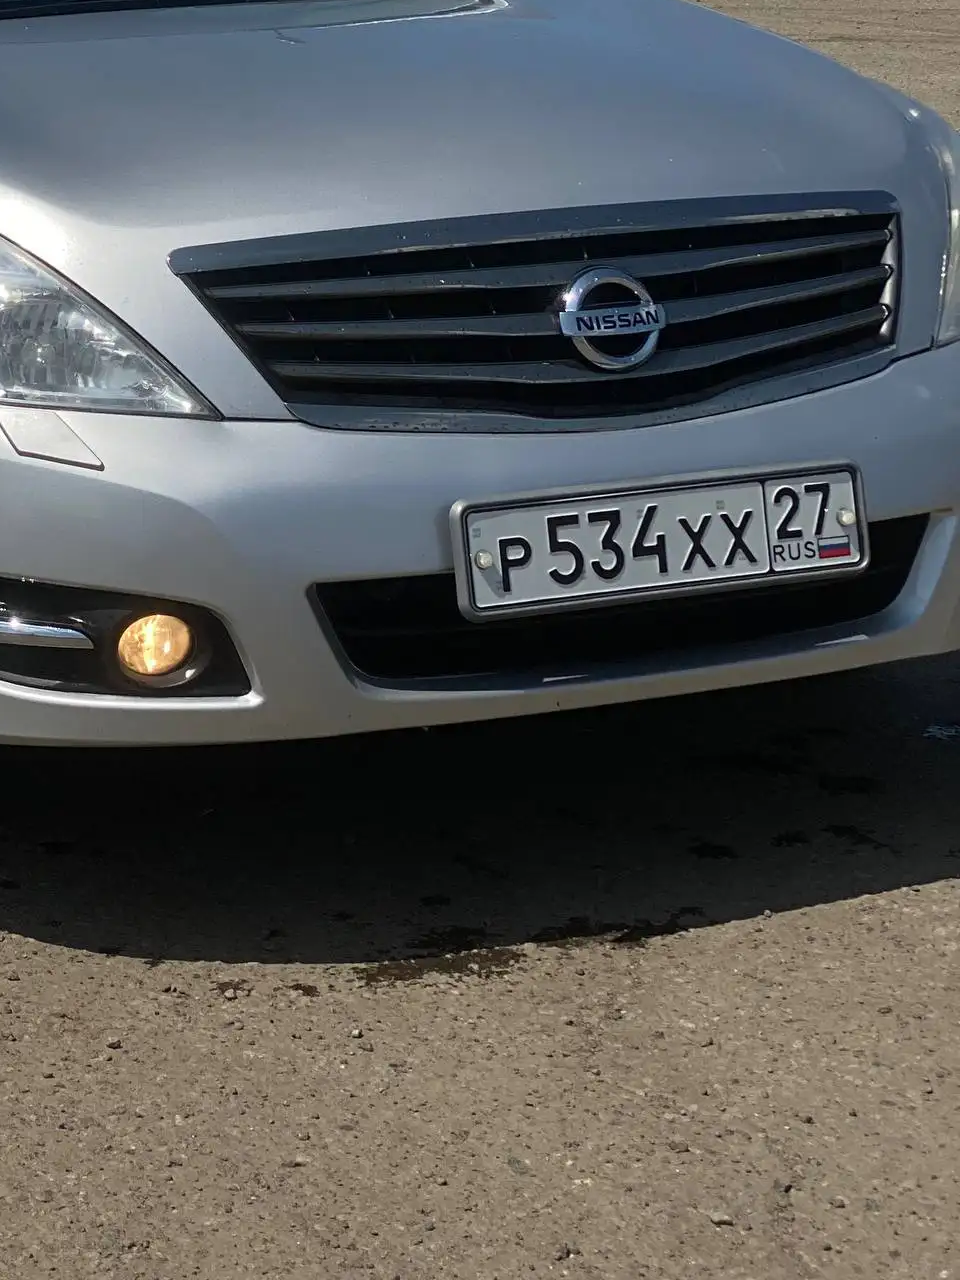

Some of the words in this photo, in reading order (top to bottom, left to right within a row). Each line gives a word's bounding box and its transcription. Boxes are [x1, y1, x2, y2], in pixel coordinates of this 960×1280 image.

[575, 309, 660, 332] NISSAN
[772, 481, 832, 540] 27
[772, 540, 817, 564] RUS
